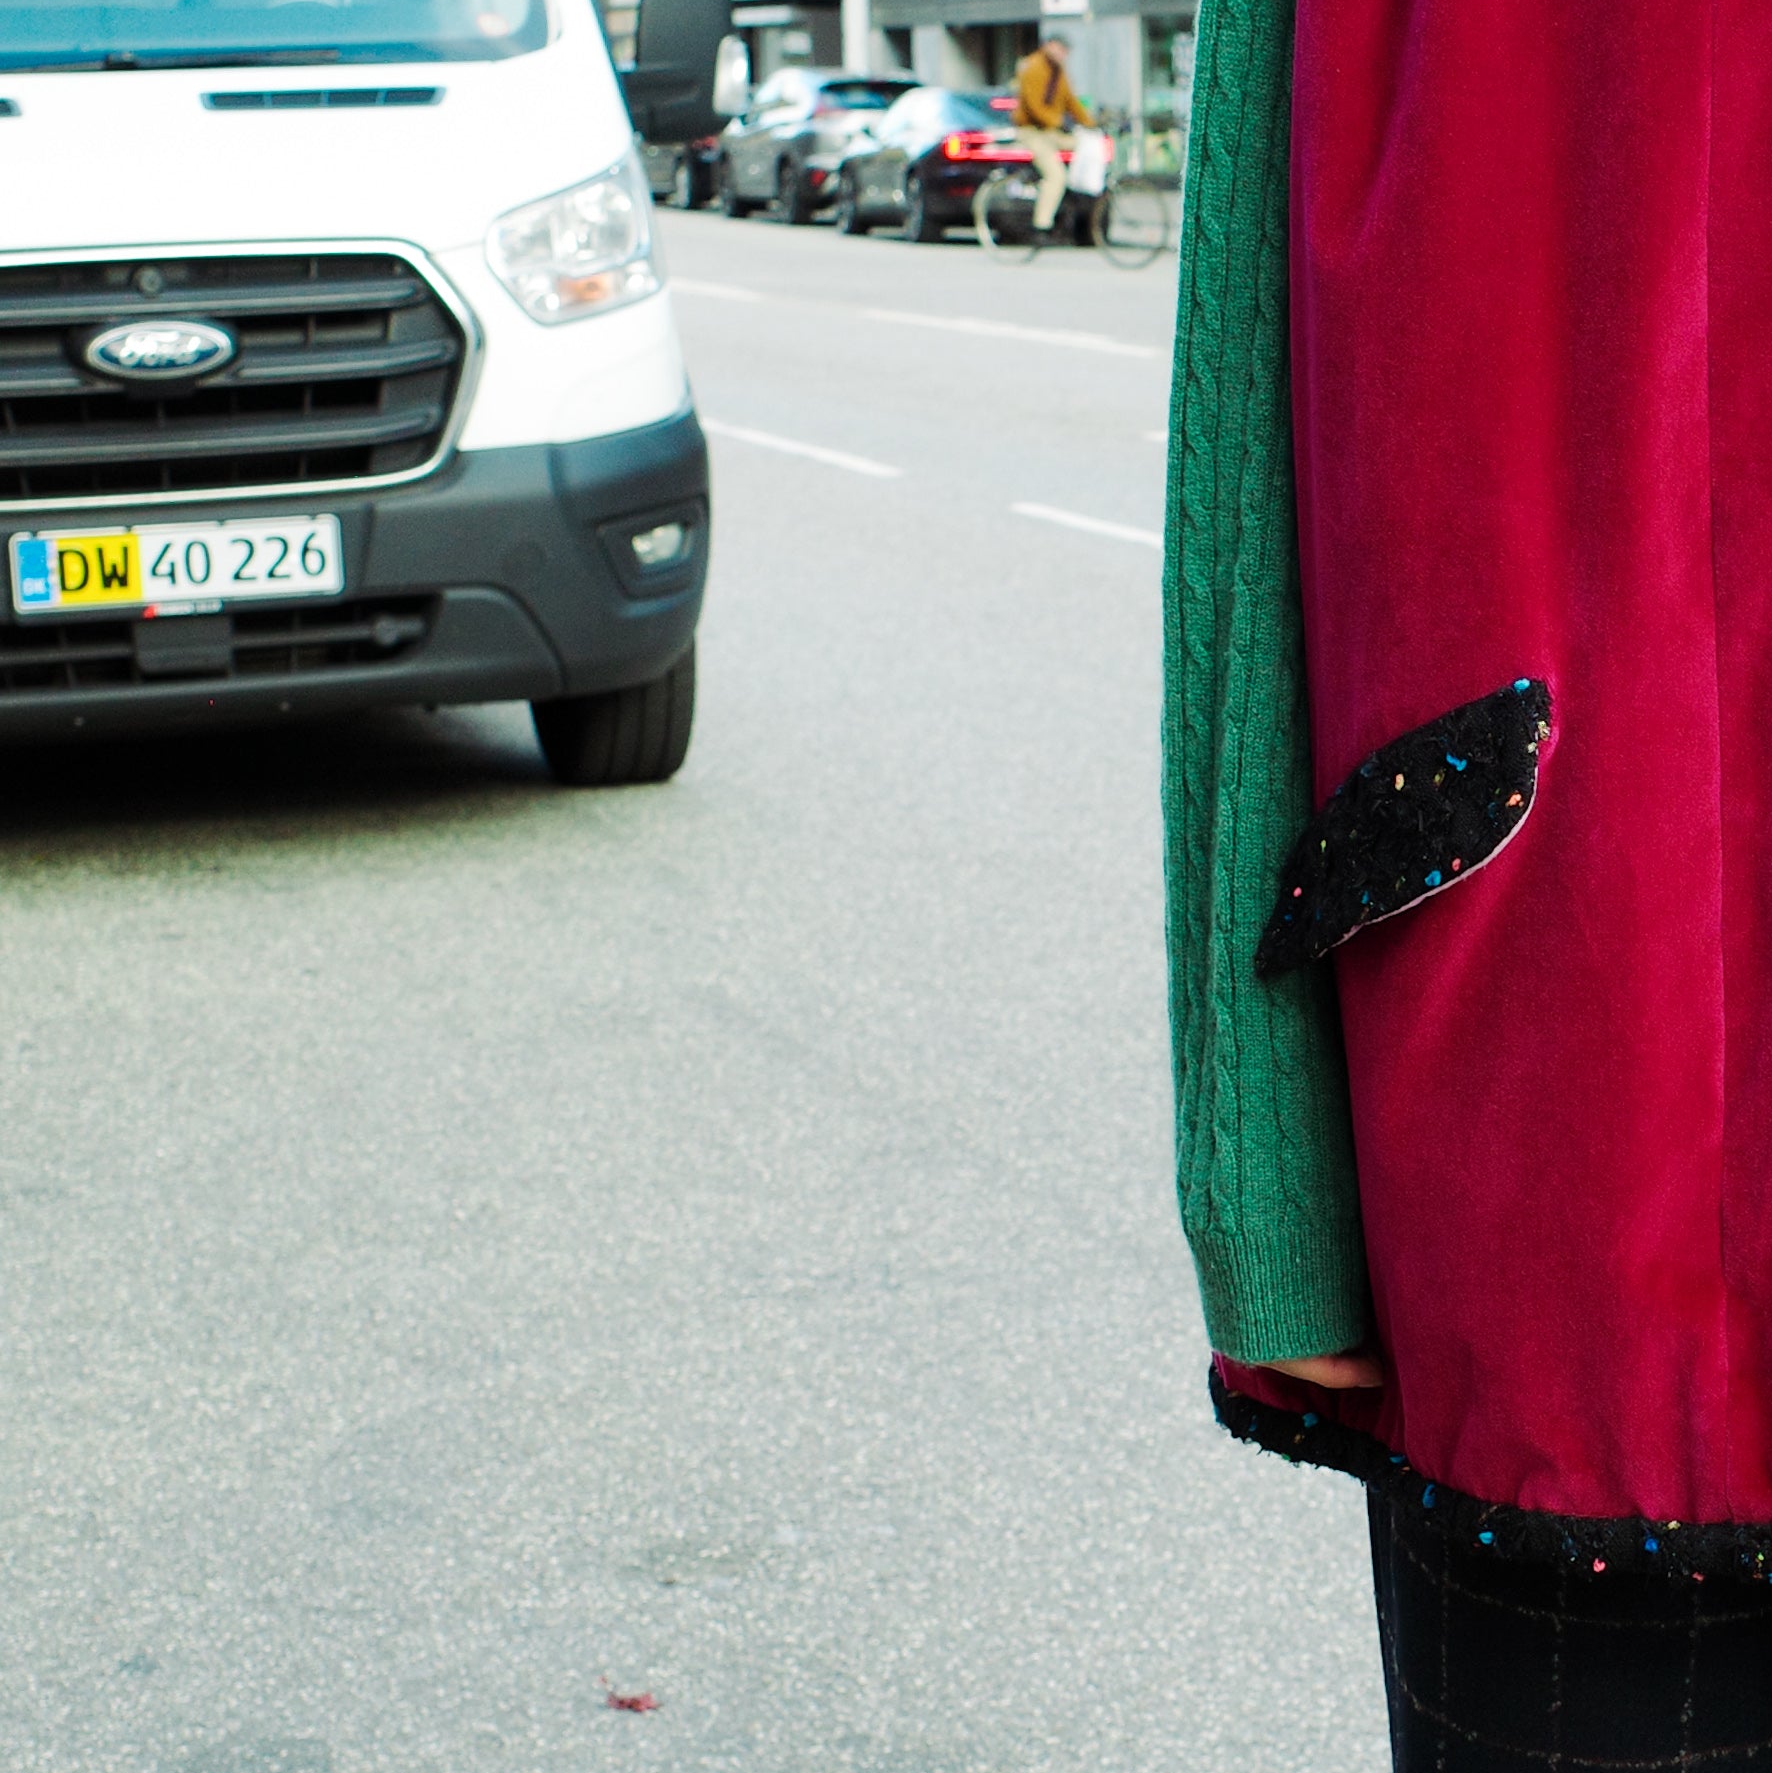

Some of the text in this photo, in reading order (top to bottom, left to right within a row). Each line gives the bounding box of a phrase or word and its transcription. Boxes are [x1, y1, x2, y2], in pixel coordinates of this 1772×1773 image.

[57, 532, 326, 592] DW 40 226
